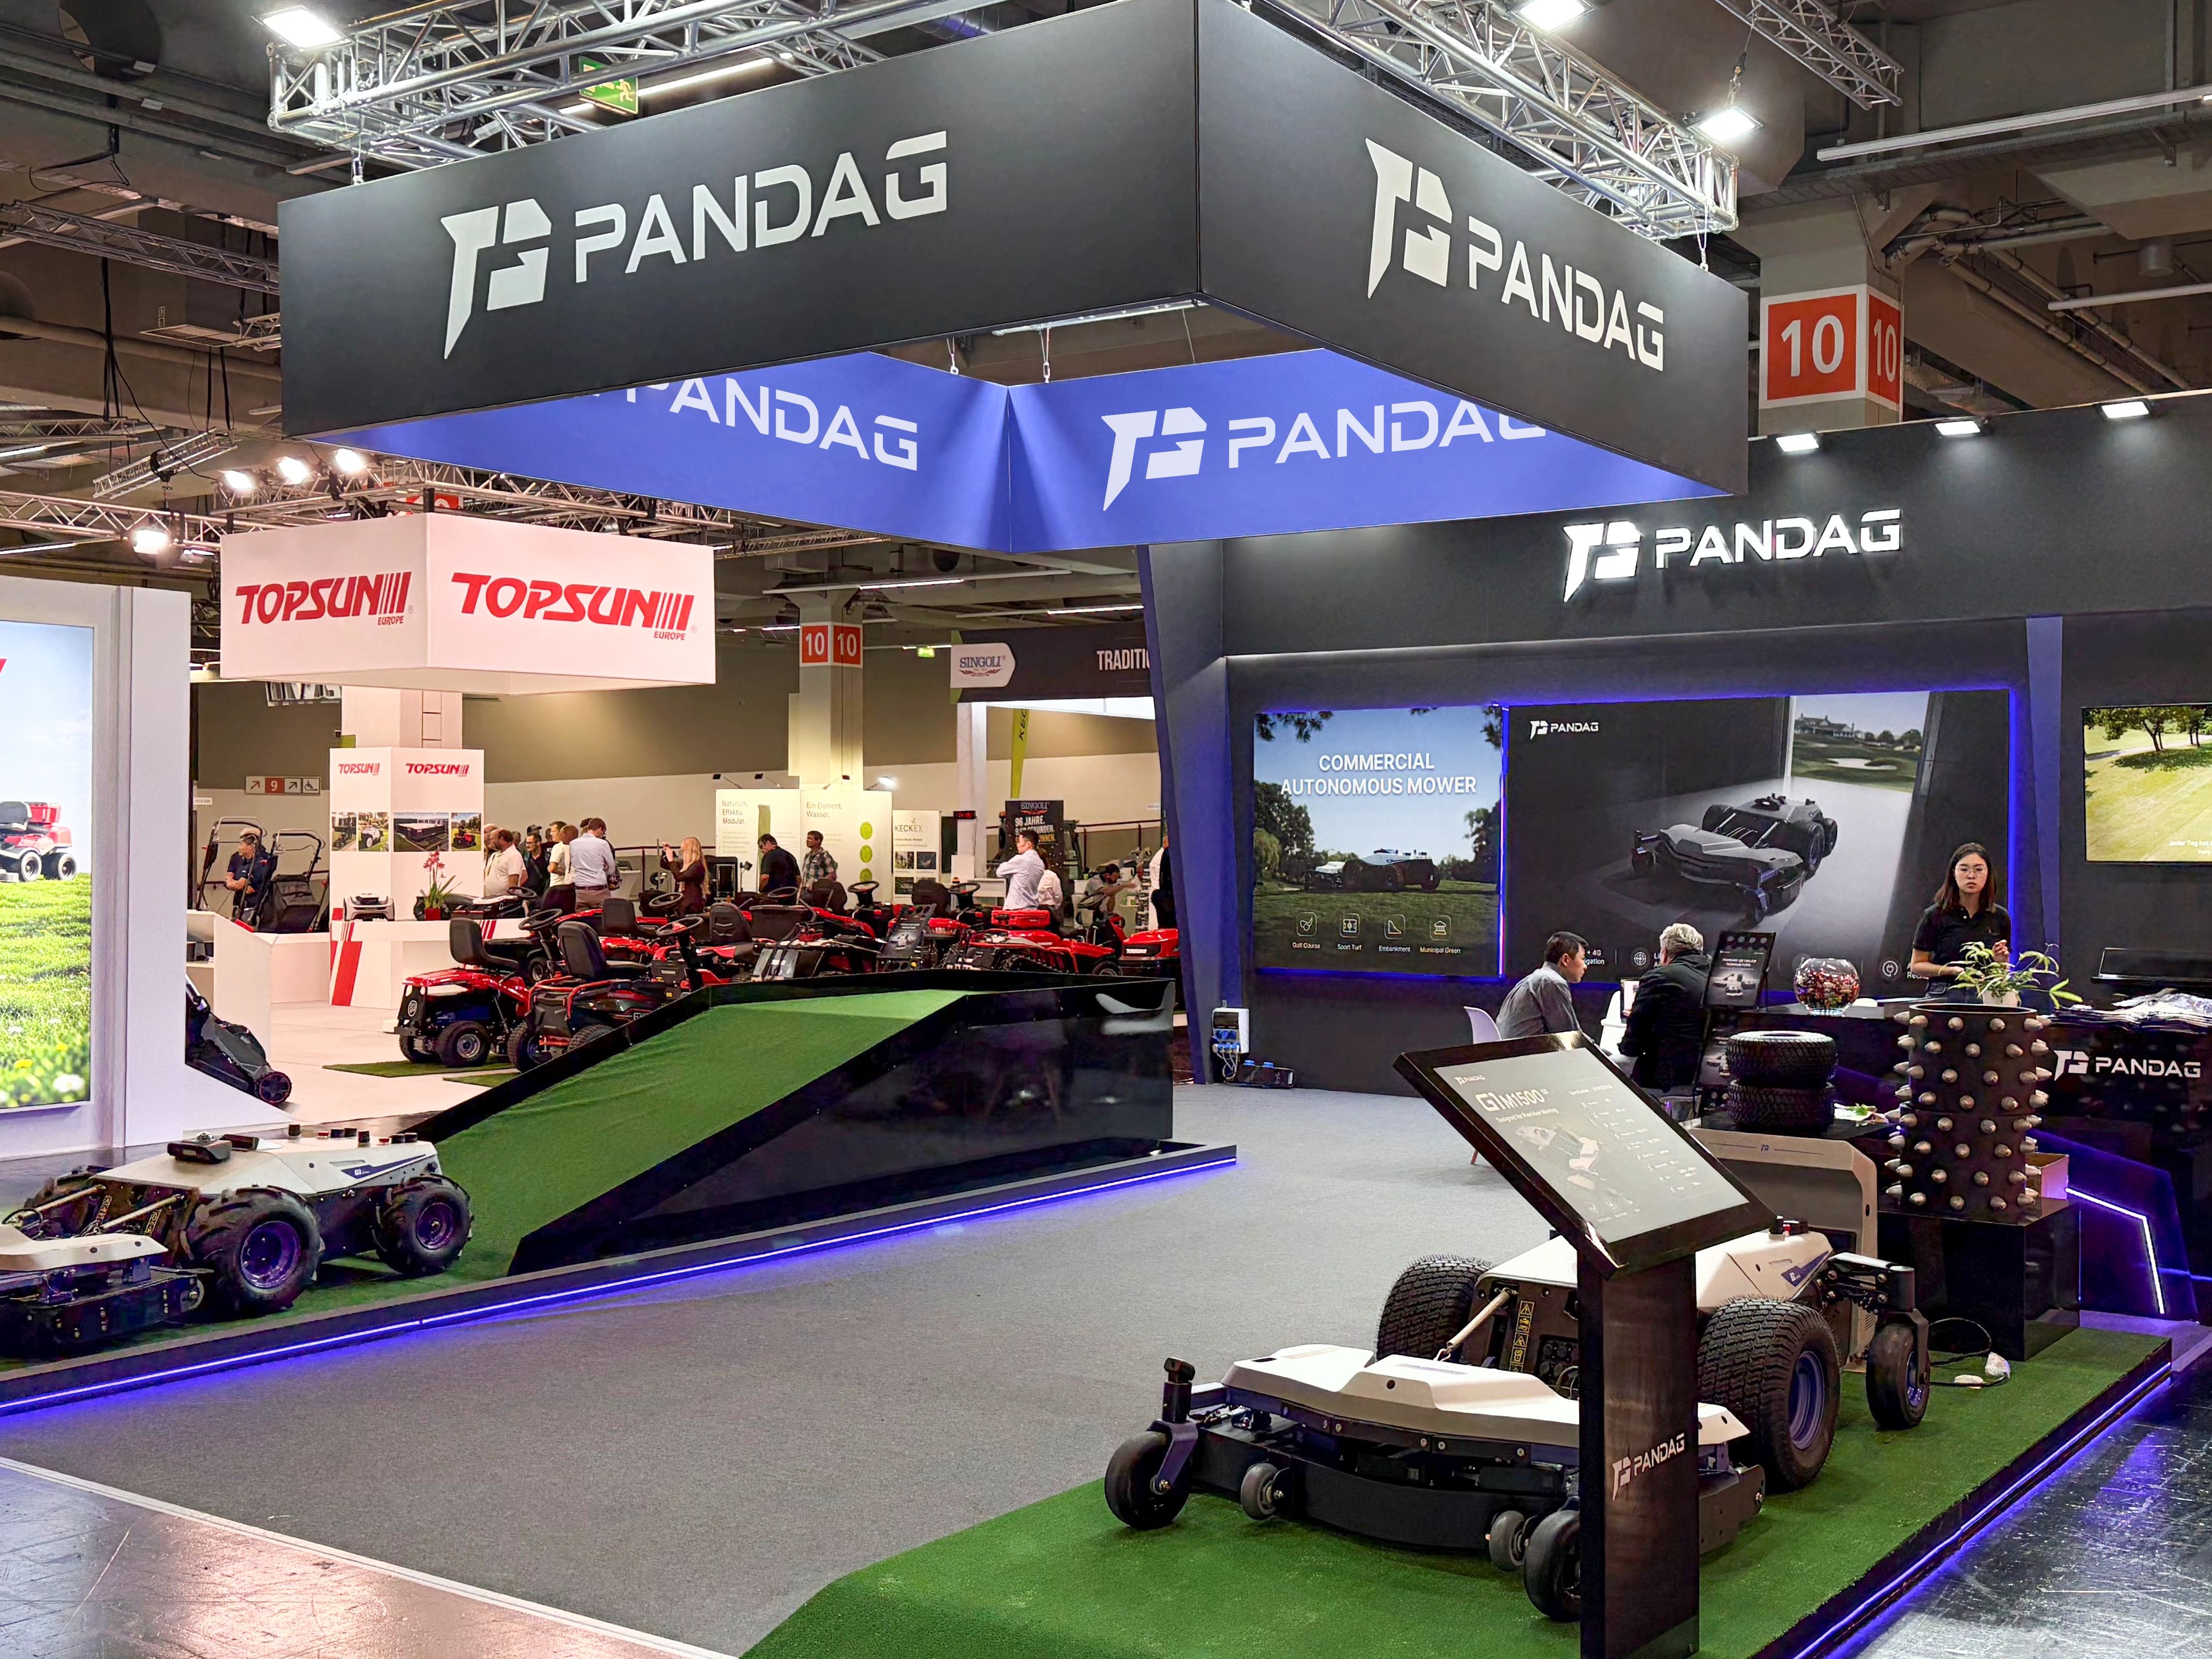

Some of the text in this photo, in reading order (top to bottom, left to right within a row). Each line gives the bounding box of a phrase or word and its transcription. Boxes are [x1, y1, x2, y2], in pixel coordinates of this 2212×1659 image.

[576, 130, 947, 283] PANDAG
[1469, 215, 1663, 371] PANDAG
[1781, 315, 1845, 377] 10
[1874, 318, 1897, 382] 10
[1656, 509, 1900, 568] PANDAG
[235, 572, 384, 624] TOPSUN
[451, 572, 661, 628] TOPSUN
[377, 616, 404, 625] EUROPE
[654, 631, 686, 641] EUROPE
[805, 632, 825, 656] 10
[837, 633, 857, 657] 10
[960, 656, 1001, 668] SINGOLI
[1019, 709, 1027, 741] KEC
[1551, 722, 1599, 732] PANDAG
[338, 763, 373, 774] TOPSUN
[406, 763, 461, 774] TOPSUN
[1319, 753, 1435, 771] COMMERCIAL
[271, 780, 278, 791] 9
[1280, 776, 1477, 795] AUTONOMOUS MOWER
[1015, 816, 1045, 827] 96 JAHRE.
[2096, 1057, 2201, 1078] PANDAG
[1634, 1432, 1685, 1476] PANDAG
